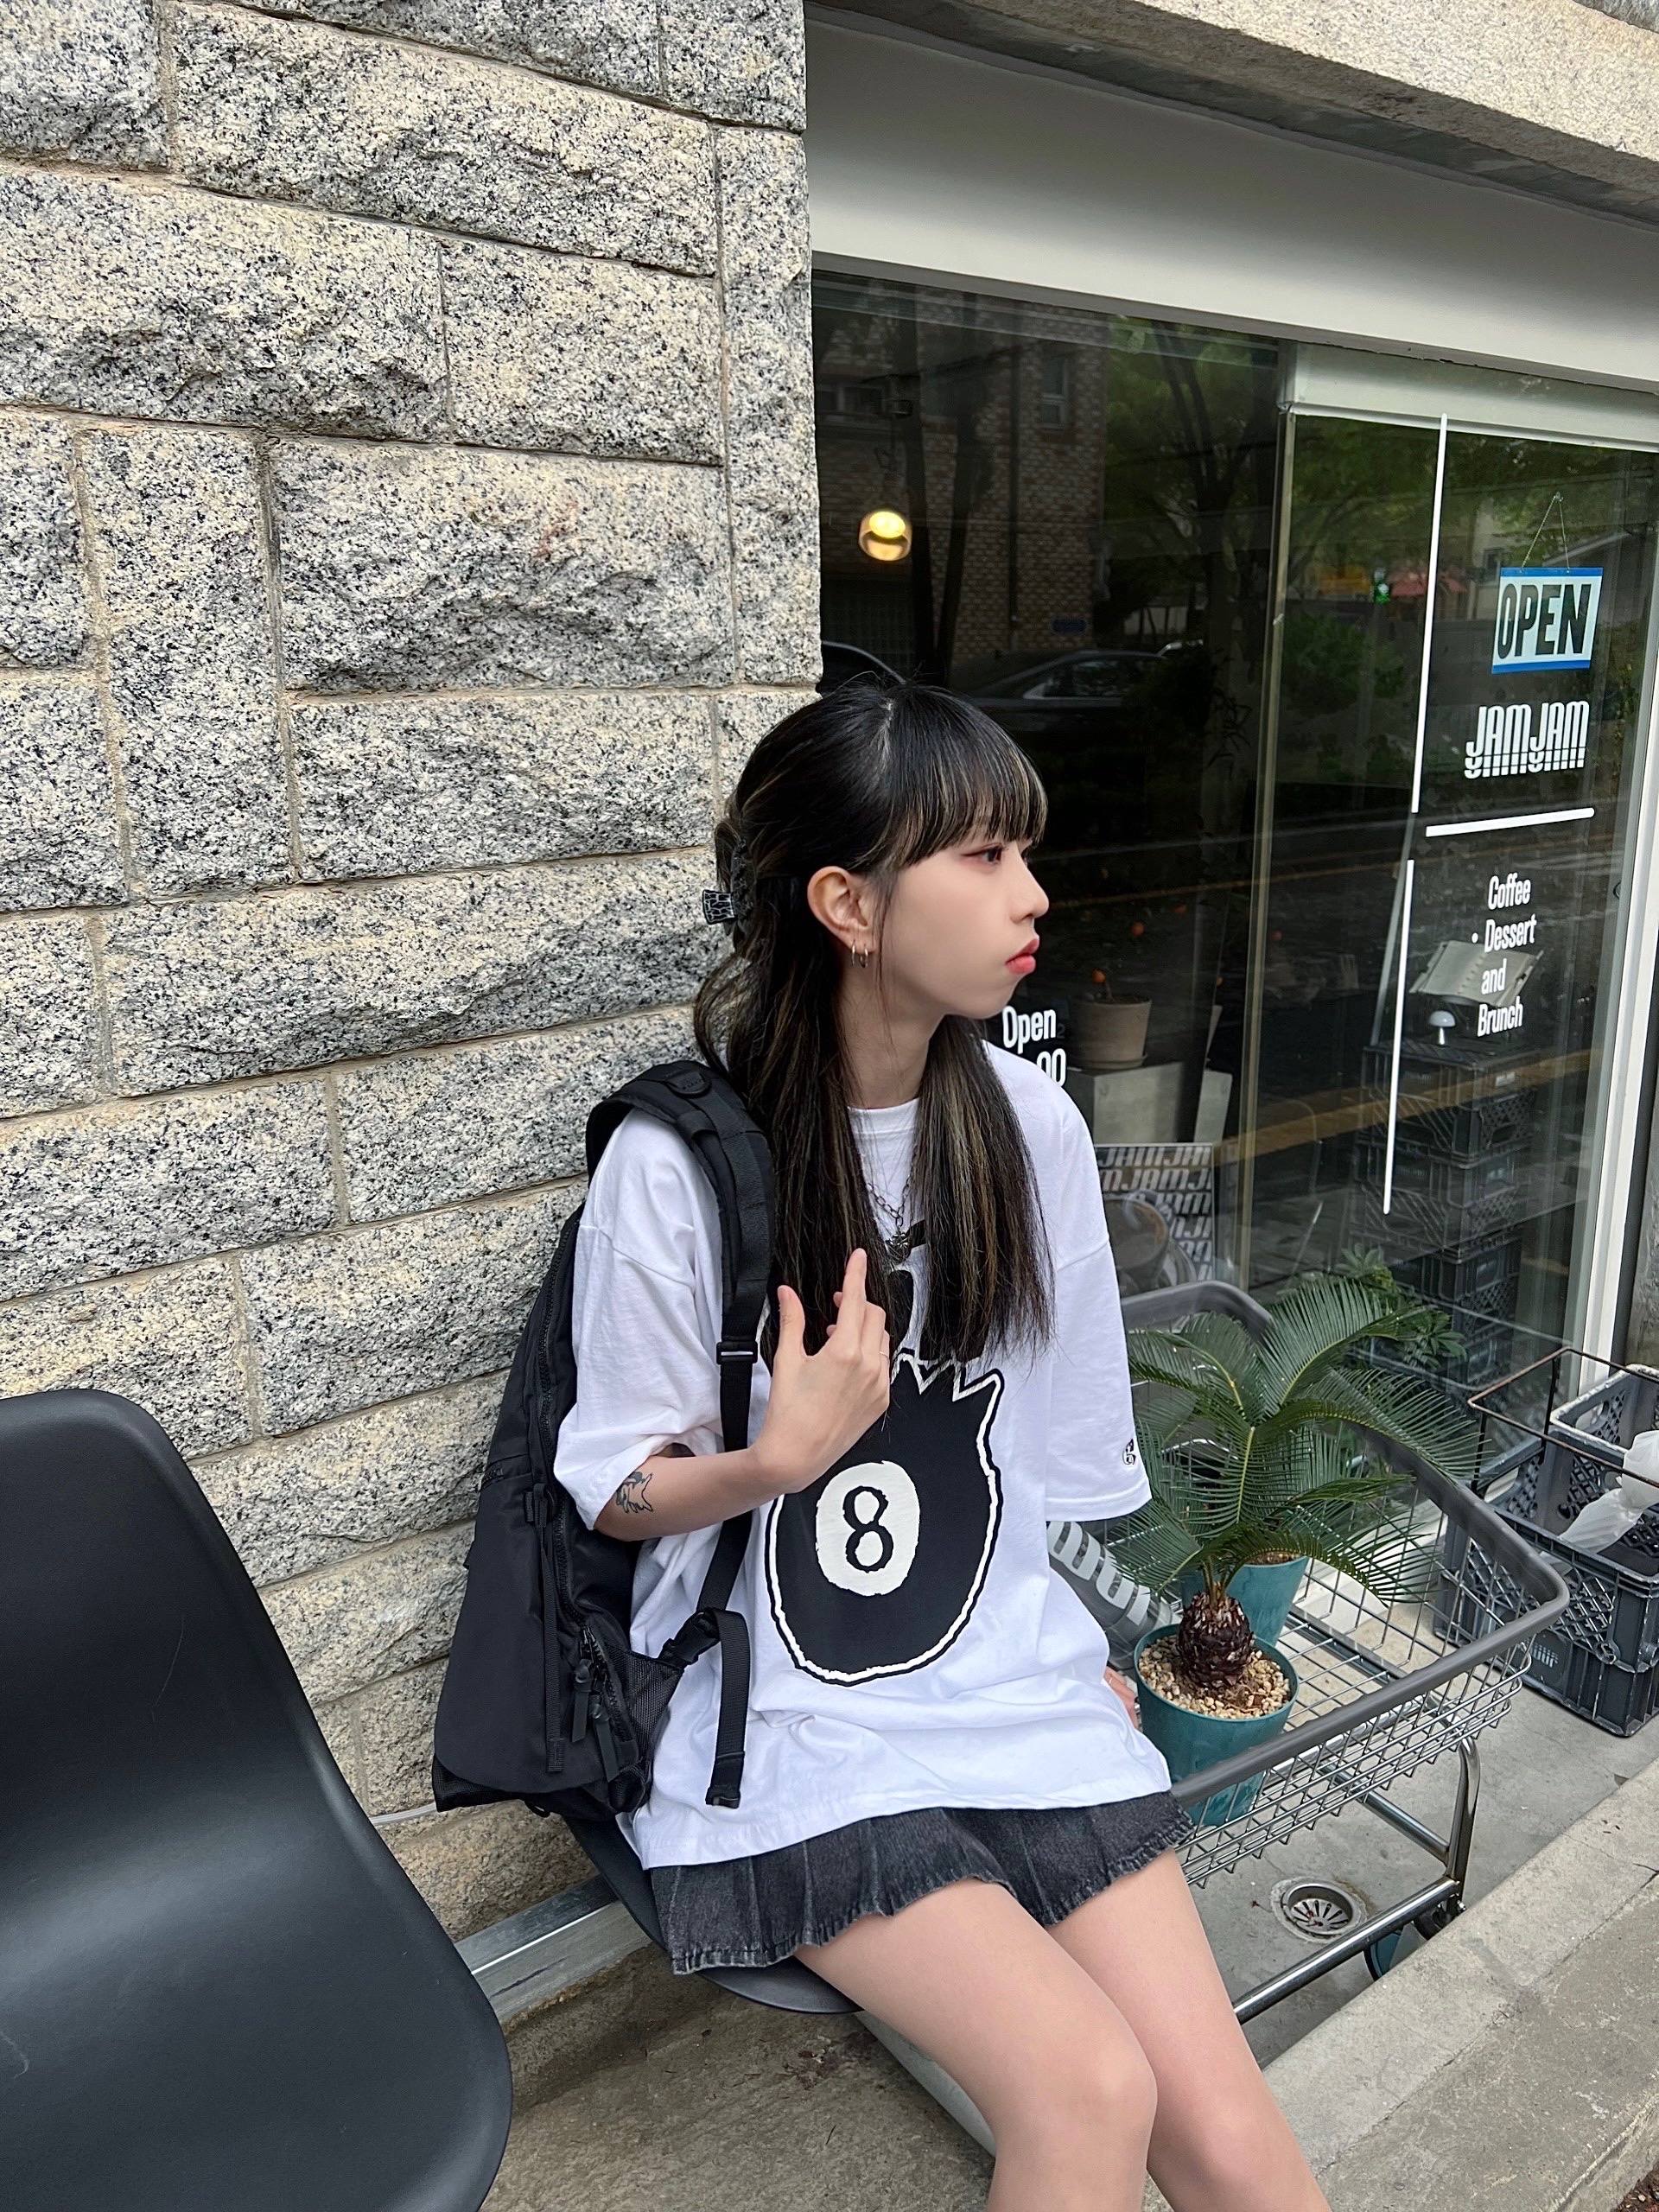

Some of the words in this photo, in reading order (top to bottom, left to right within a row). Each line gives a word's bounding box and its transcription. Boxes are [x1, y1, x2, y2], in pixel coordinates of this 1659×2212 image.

[1497, 582, 1592, 659] OPEN
[1465, 701, 1590, 779] JAMJAM
[1488, 872, 1532, 910] Coffee
[1484, 913, 1537, 952] Dessert
[1481, 957, 1508, 995] and
[1002, 1005, 1057, 1054] Open
[1478, 995, 1524, 1037] Brunch
[842, 1485, 893, 1573] 8
